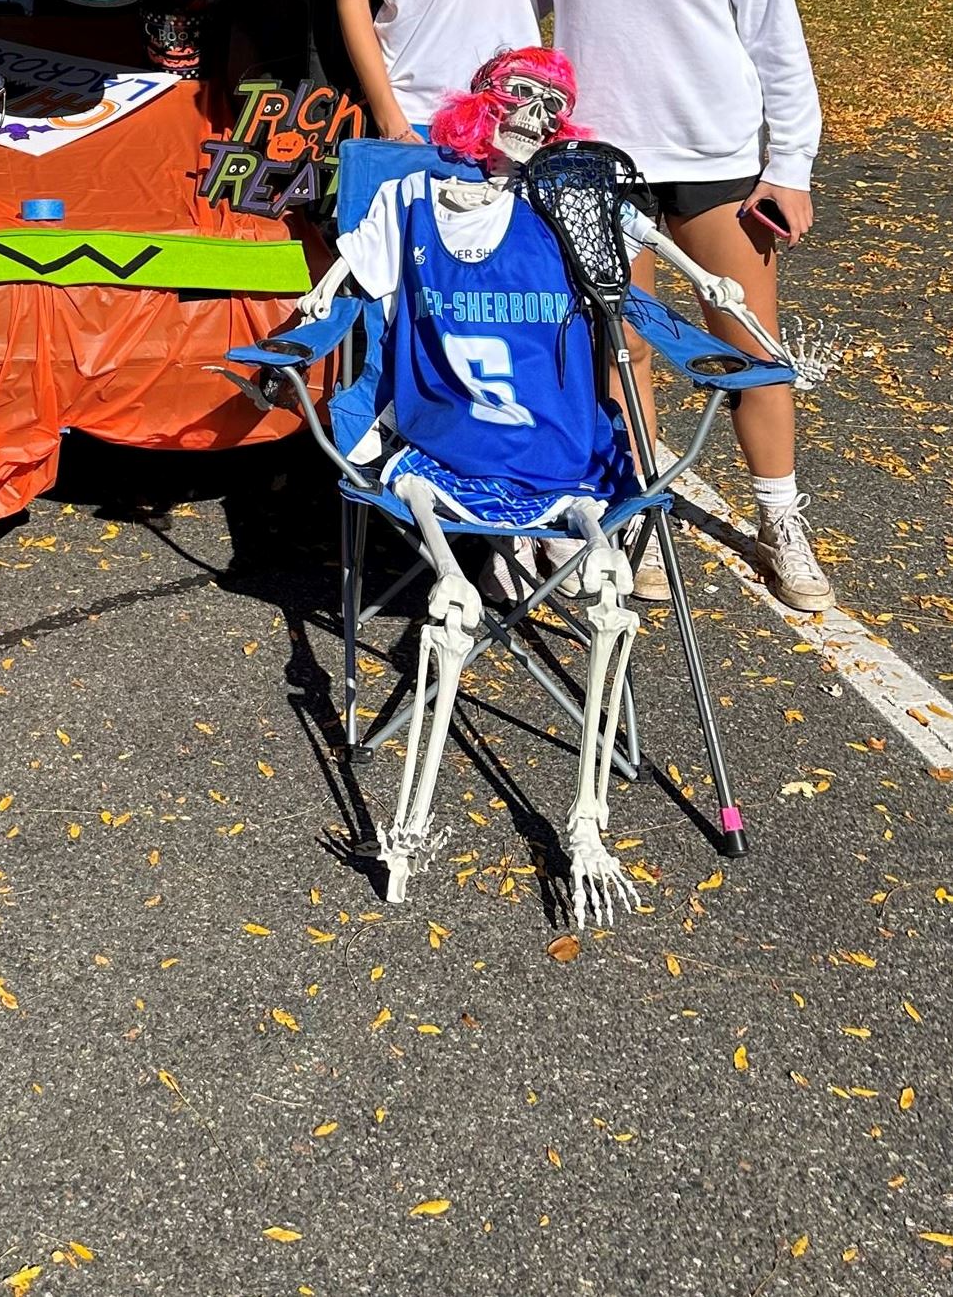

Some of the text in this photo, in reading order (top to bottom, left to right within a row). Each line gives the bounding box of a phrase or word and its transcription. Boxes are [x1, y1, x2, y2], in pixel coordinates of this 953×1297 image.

[233, 82, 364, 143] TRICK
[201, 142, 340, 213] TREAT
[442, 331, 536, 428] 6
[618, 349, 629, 362] G
